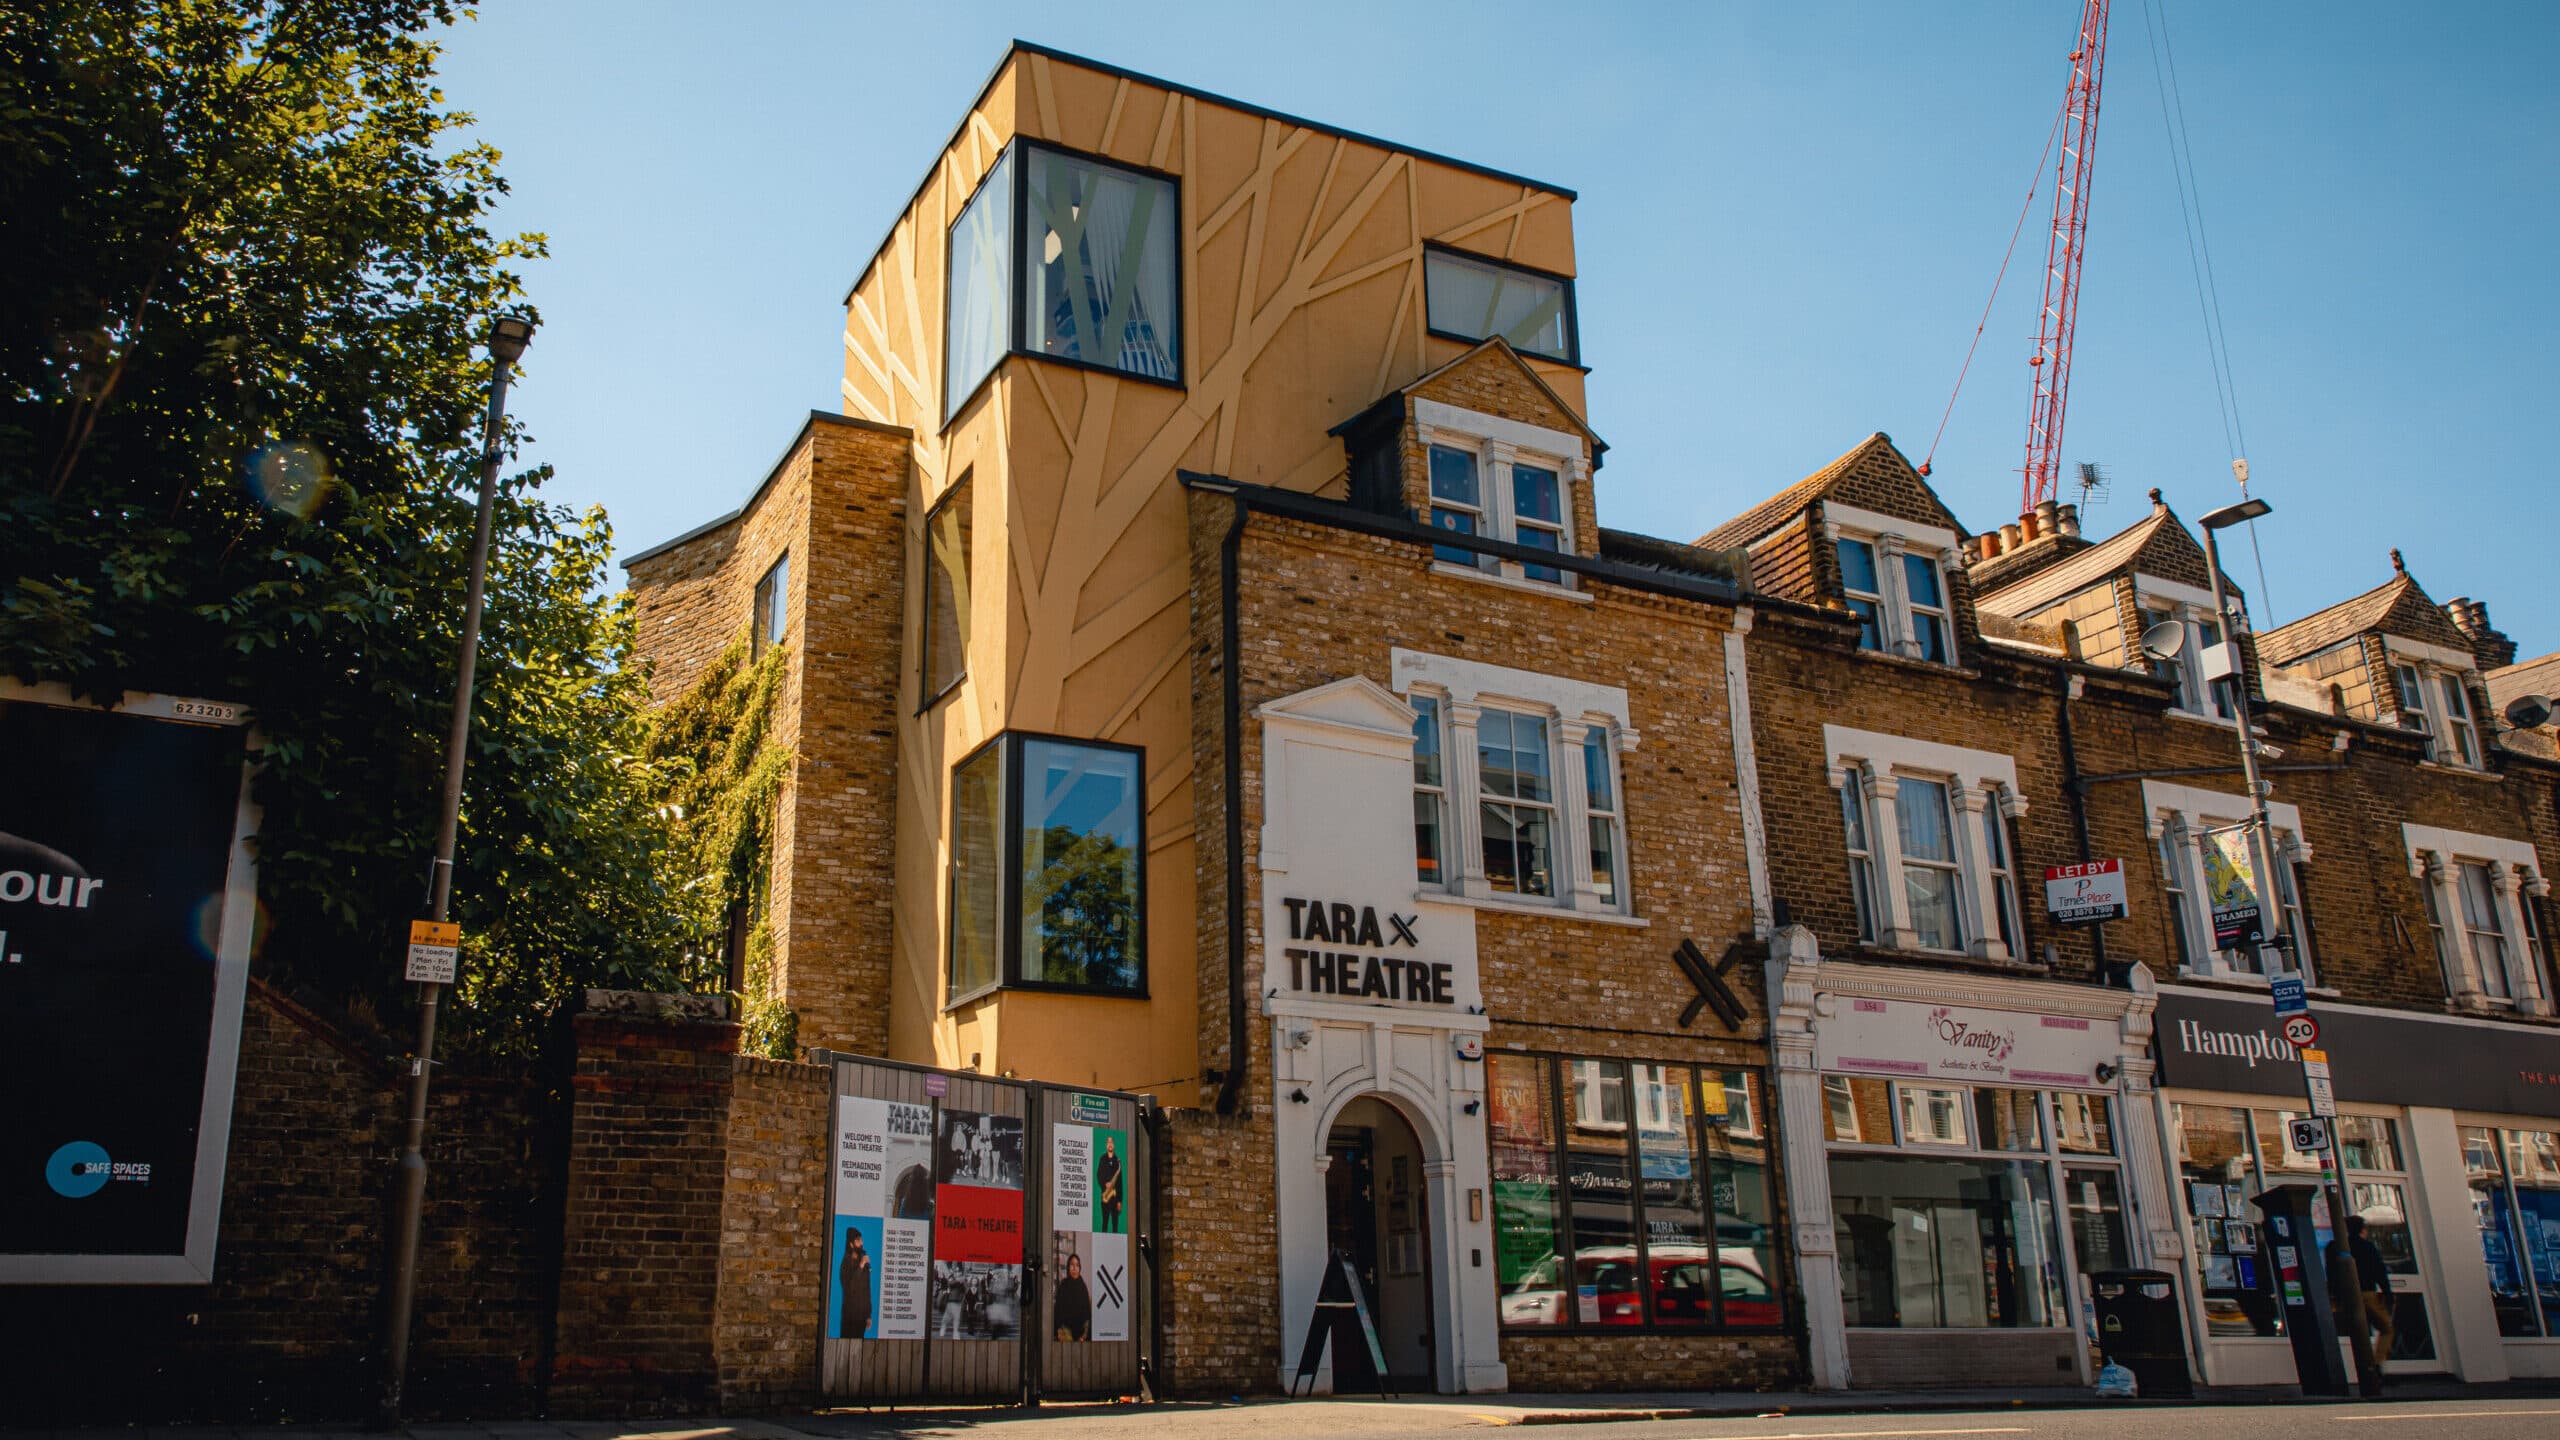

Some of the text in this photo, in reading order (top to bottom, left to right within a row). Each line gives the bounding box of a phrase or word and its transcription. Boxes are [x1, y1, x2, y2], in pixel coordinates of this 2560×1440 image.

[2057, 861, 2107, 878] LET BY
[0, 870, 104, 908] our
[1284, 897, 1384, 947] TARA
[2214, 908, 2258, 923] FRAMED
[413, 946, 453, 957] No loading
[1285, 948, 1455, 1004] THEATRE
[2275, 986, 2300, 996] CCTV
[2289, 1024, 2313, 1037] 20
[1939, 1019, 2001, 1057] Vanity
[2178, 1019, 2301, 1067] Hampton
[889, 1104, 919, 1120] TARA
[845, 1132, 881, 1143] WELCOME TO
[1058, 1139, 1088, 1149] POLITICALLY
[843, 1141, 883, 1152] TARA THEATRE
[85, 1162, 151, 1175] SAFE SPACES
[842, 1160, 881, 1172] REIMAGINING
[843, 1171, 880, 1181] YOUR WORLD
[1070, 1182, 1087, 1191] WORLD
[1067, 1208, 1080, 1216] LENS
[942, 1216, 967, 1230] TARA
[977, 1218, 1017, 1233] THEATRE
[1650, 1221, 1675, 1234] TARA
